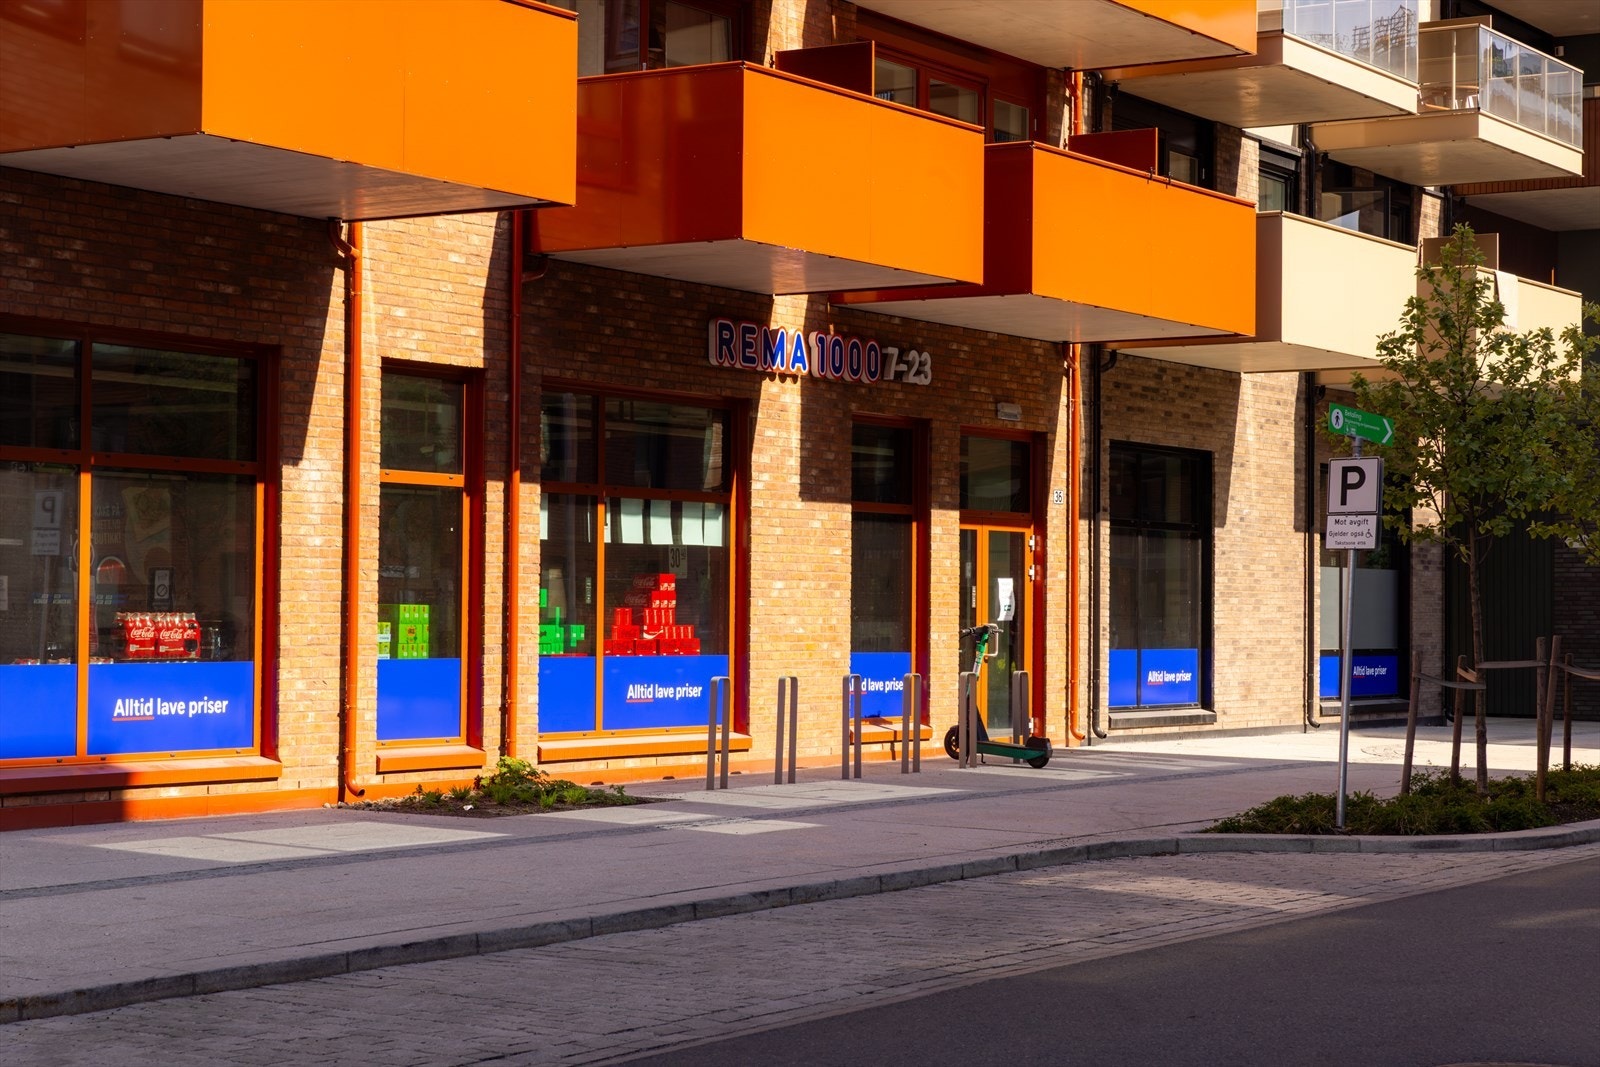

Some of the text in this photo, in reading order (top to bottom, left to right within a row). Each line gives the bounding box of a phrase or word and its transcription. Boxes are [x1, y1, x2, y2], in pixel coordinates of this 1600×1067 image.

[710, 317, 932, 386] REMA 1000 7-23
[1340, 465, 1366, 506] P
[1334, 518, 1369, 527] Mot avgift
[1329, 530, 1364, 538] Gjelder også
[130, 627, 155, 638] Coca-Cola
[160, 628, 183, 640] Coca-Cola
[1148, 670, 1192, 684] Alltid lave priser
[1353, 665, 1387, 677] Alltid lave priser
[626, 683, 702, 701] Alltid lave priser
[867, 677, 884, 692] lave
[884, 676, 904, 694] prise
[113, 695, 229, 718] Alltid lave priser
